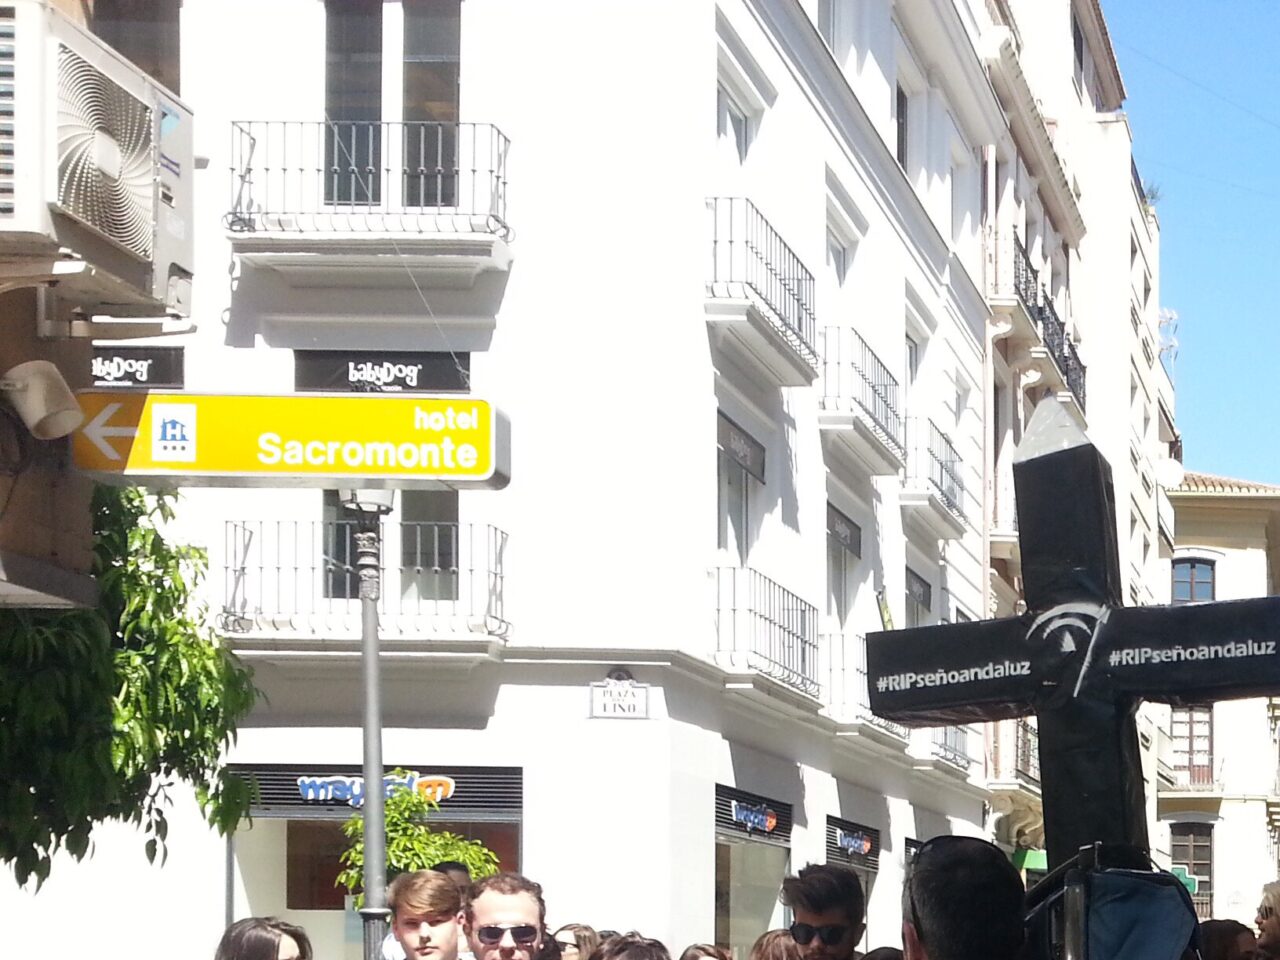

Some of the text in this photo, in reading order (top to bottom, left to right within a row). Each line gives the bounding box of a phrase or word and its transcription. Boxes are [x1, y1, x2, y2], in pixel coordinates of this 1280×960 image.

[348, 361, 419, 387] babyDog
[414, 407, 479, 431] hotel
[257, 432, 479, 469] Sacromonte
[1109, 640, 1277, 667] #RIPseñoandaluz
[876, 660, 1031, 692] #RIPseñoandaluz
